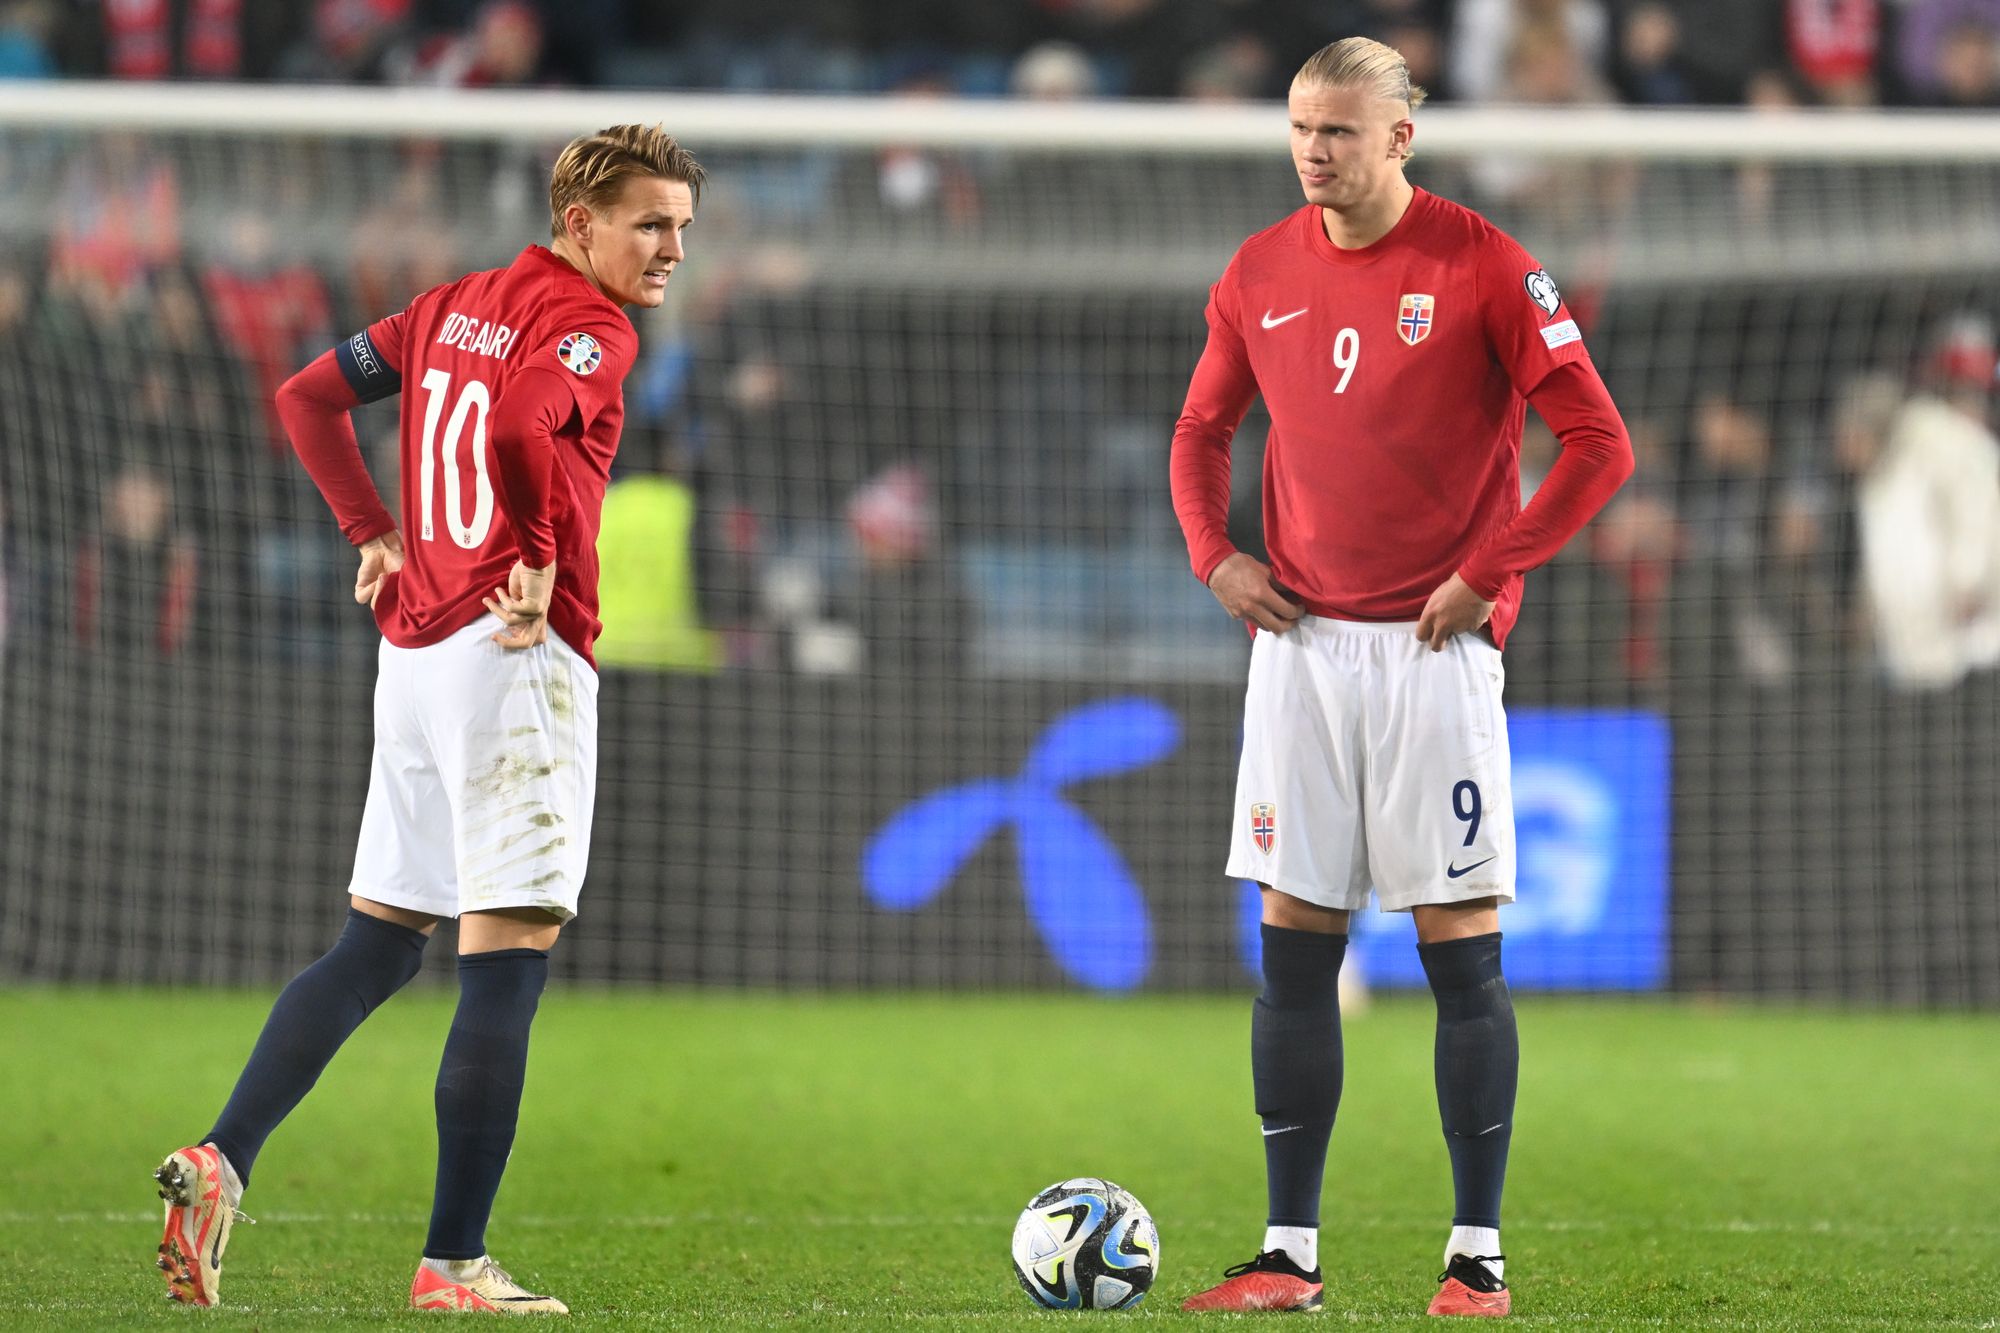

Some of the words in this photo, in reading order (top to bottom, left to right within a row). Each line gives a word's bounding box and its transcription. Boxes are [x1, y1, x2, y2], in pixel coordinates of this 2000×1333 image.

[1333, 328, 1360, 394] 9
[420, 368, 495, 549] 10
[1452, 779, 1482, 847] 9
